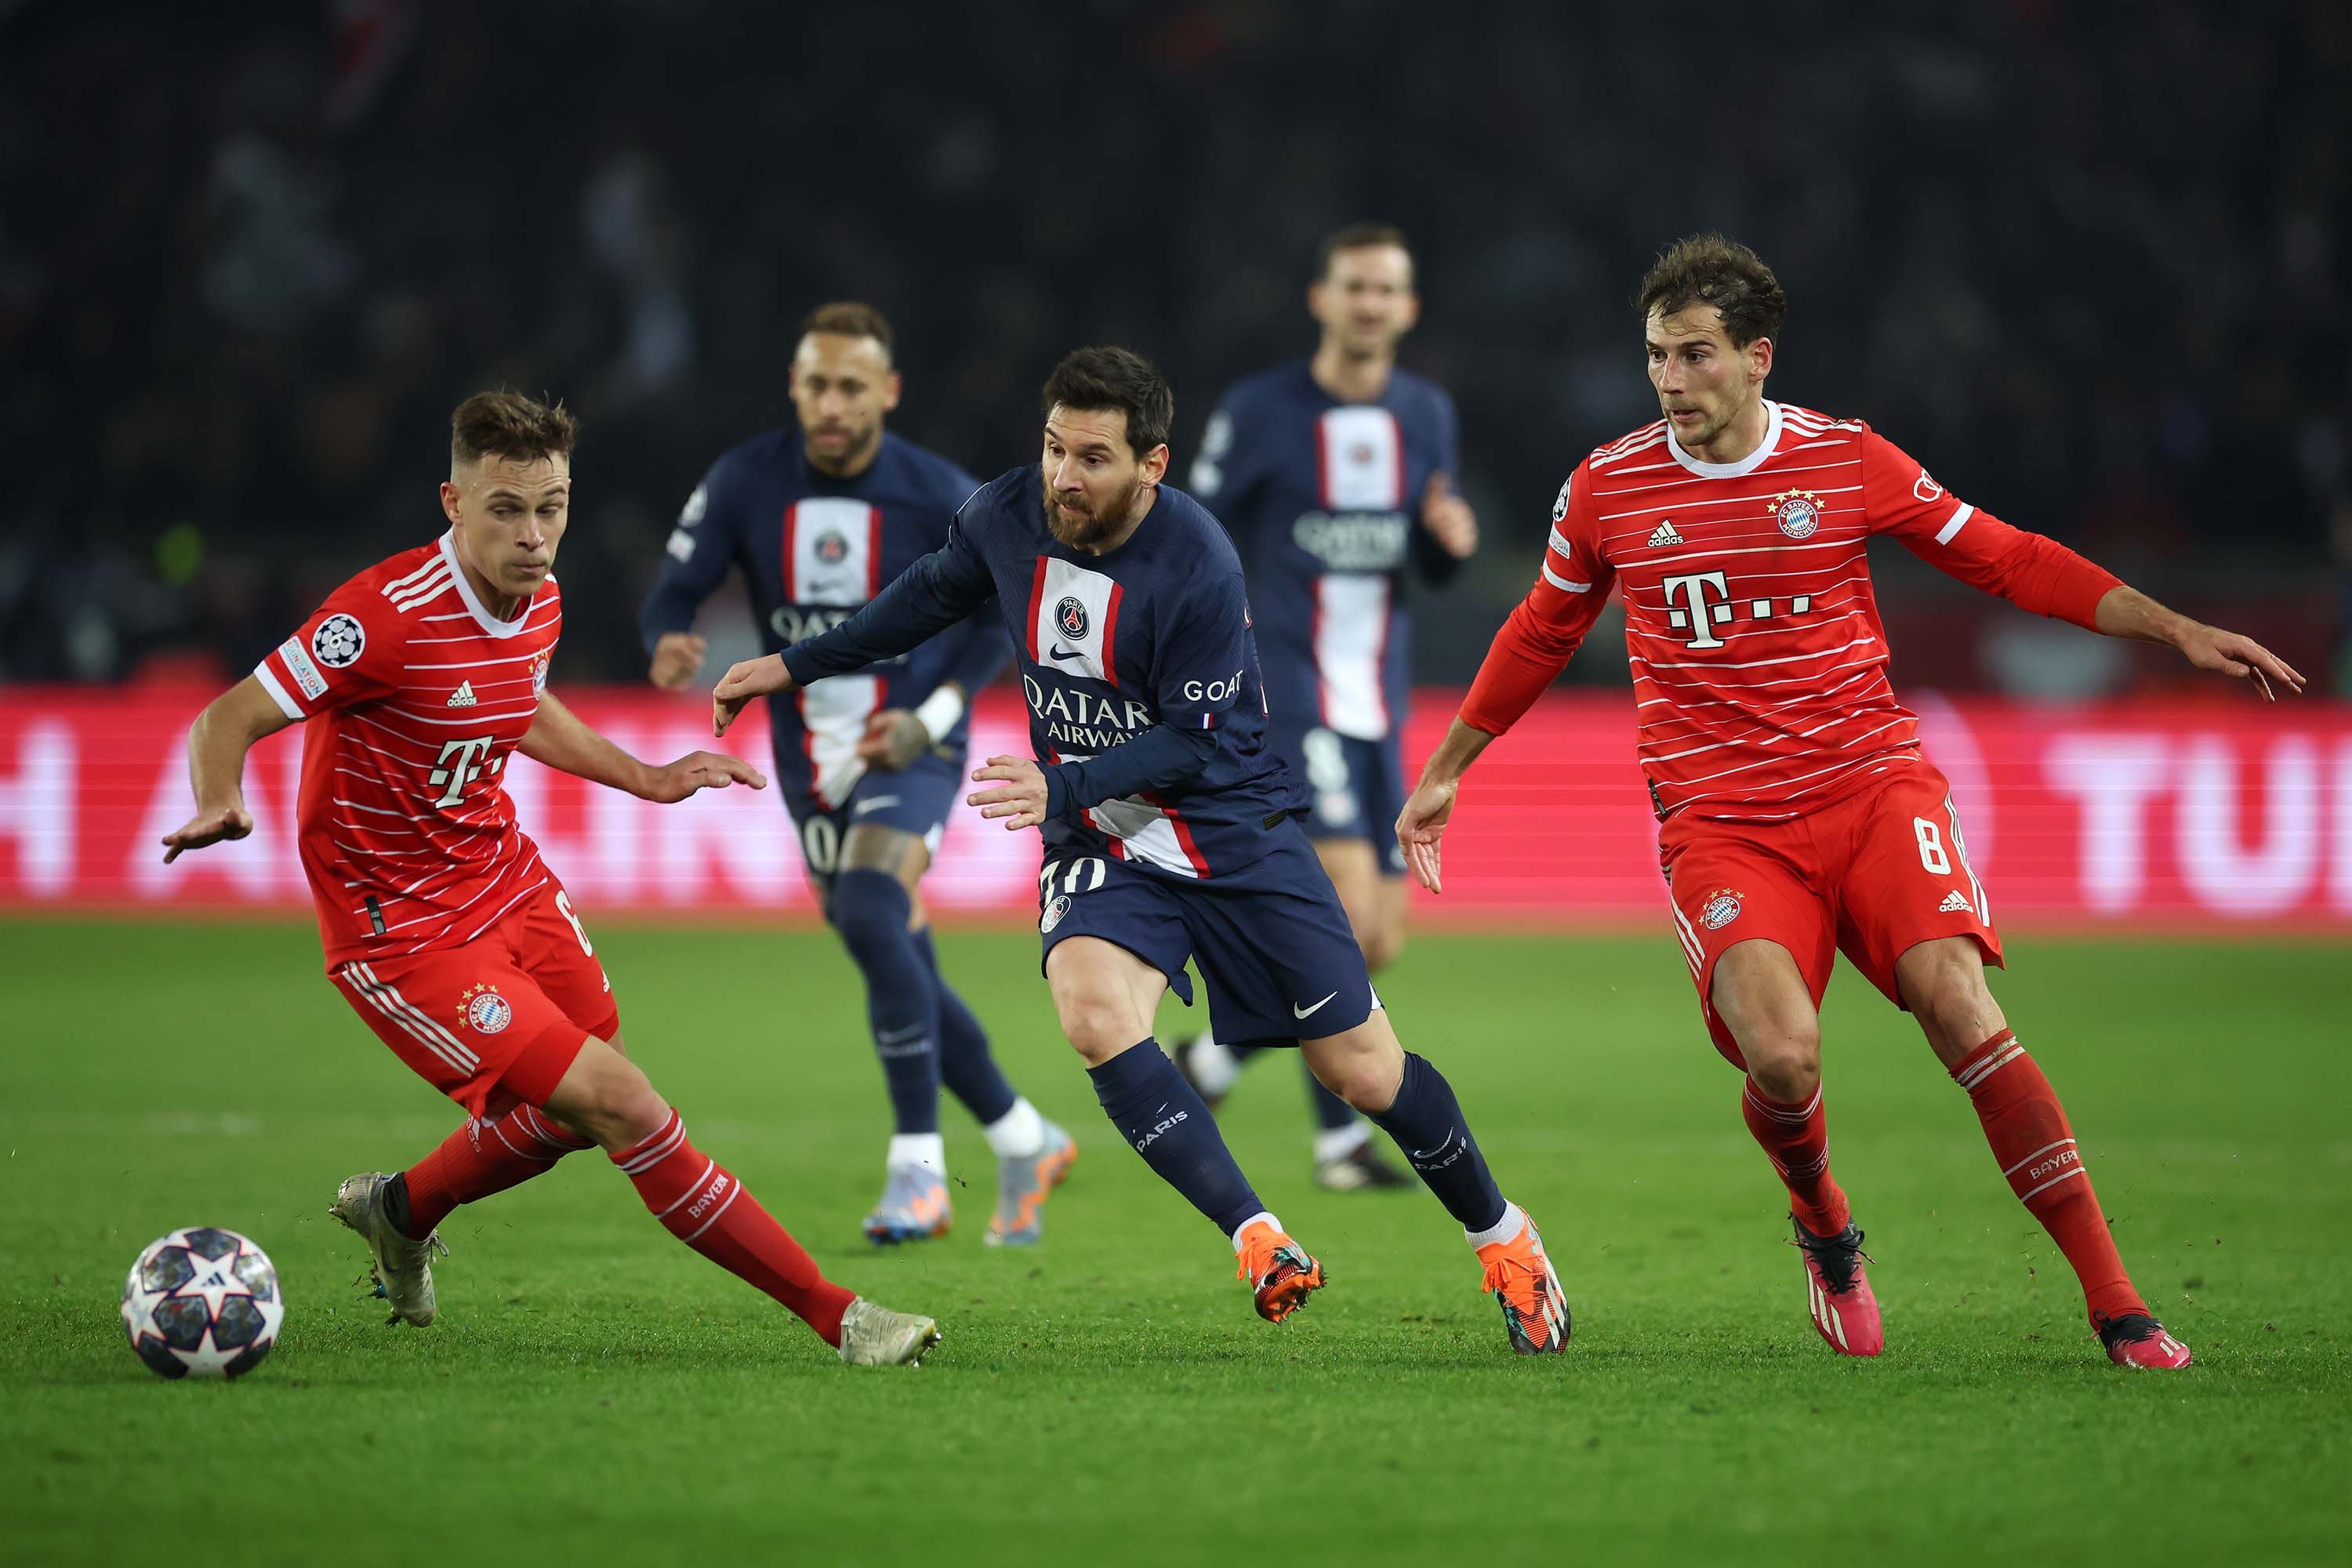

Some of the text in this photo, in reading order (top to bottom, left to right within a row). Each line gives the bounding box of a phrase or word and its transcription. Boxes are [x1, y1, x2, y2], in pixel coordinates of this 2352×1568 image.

[1788, 502, 1814, 516] BAYERN
[1647, 535, 1684, 547] adidas
[1063, 600, 1084, 614] PARIS
[1184, 669, 1243, 702] GOAT
[447, 695, 477, 707] adidas
[1023, 673, 1156, 730] QATAR
[1047, 720, 1151, 748] AIRWA
[2041, 729, 2352, 919] TU
[1913, 816, 1952, 876] 8
[1939, 902, 1974, 913] adidas
[555, 889, 593, 958] 6
[1136, 1110, 1189, 1153] PARIS
